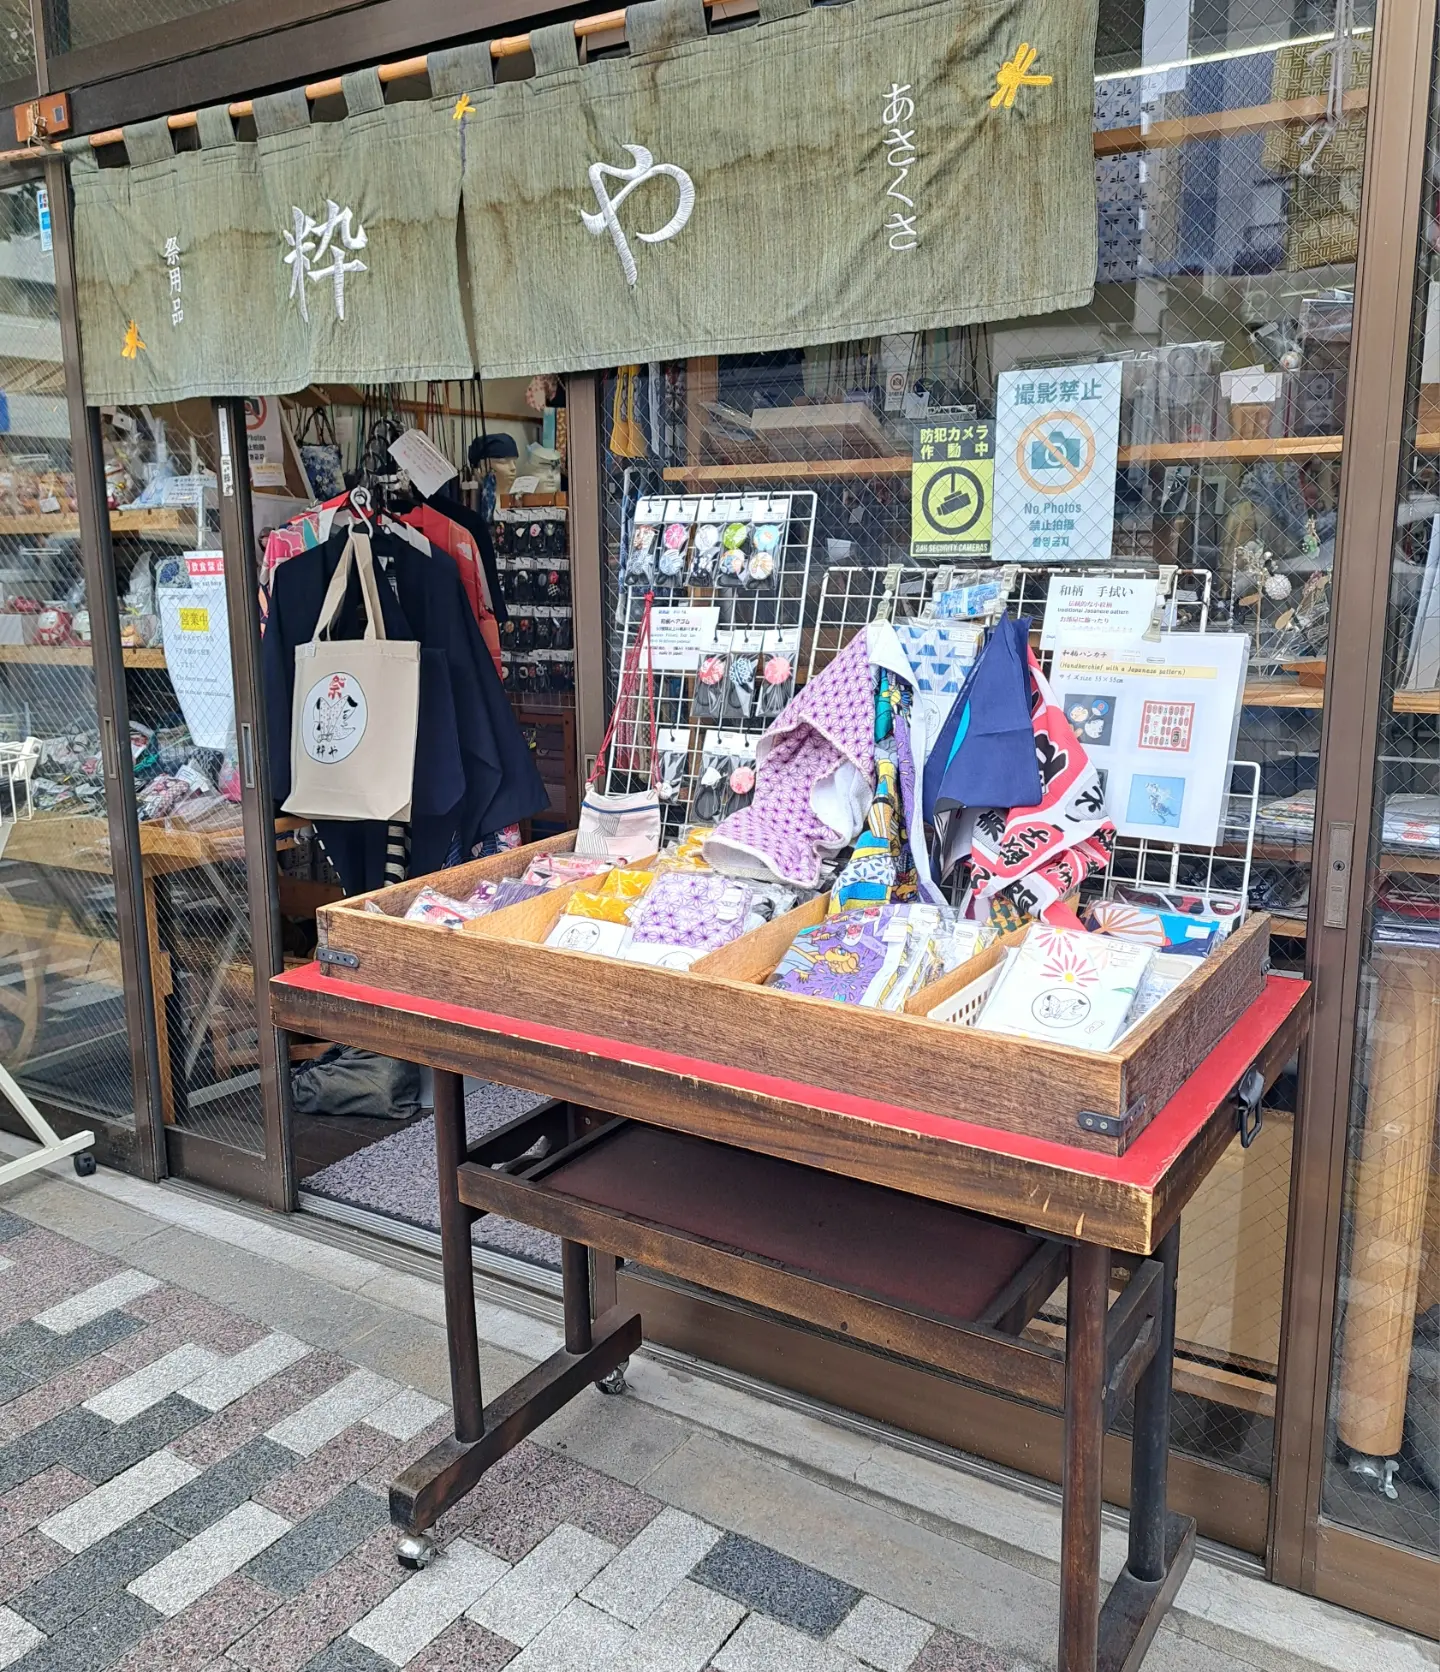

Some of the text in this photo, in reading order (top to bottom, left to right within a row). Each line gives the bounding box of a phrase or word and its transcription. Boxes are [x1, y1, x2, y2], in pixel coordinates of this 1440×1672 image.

[882, 83, 917, 250] あさくさ
[282, 143, 695, 323] 粋 や
[164, 236, 184, 326] 祭用品
[1014, 377, 1102, 406] 撮影禁止
[920, 424, 989, 443] 防犯カメラ
[920, 441, 989, 460] 作動中
[1024, 501, 1082, 514] No Photos
[929, 543, 957, 553] SECURITY
[958, 542, 988, 552] CAMERAS
[1060, 584, 1134, 598] 和柄 手拭い
[181, 611, 208, 626] 営業中
[1062, 649, 1108, 659] 和柄ハンカチ
[1128, 666, 1157, 674] Japanese
[328, 675, 345, 700] 祭
